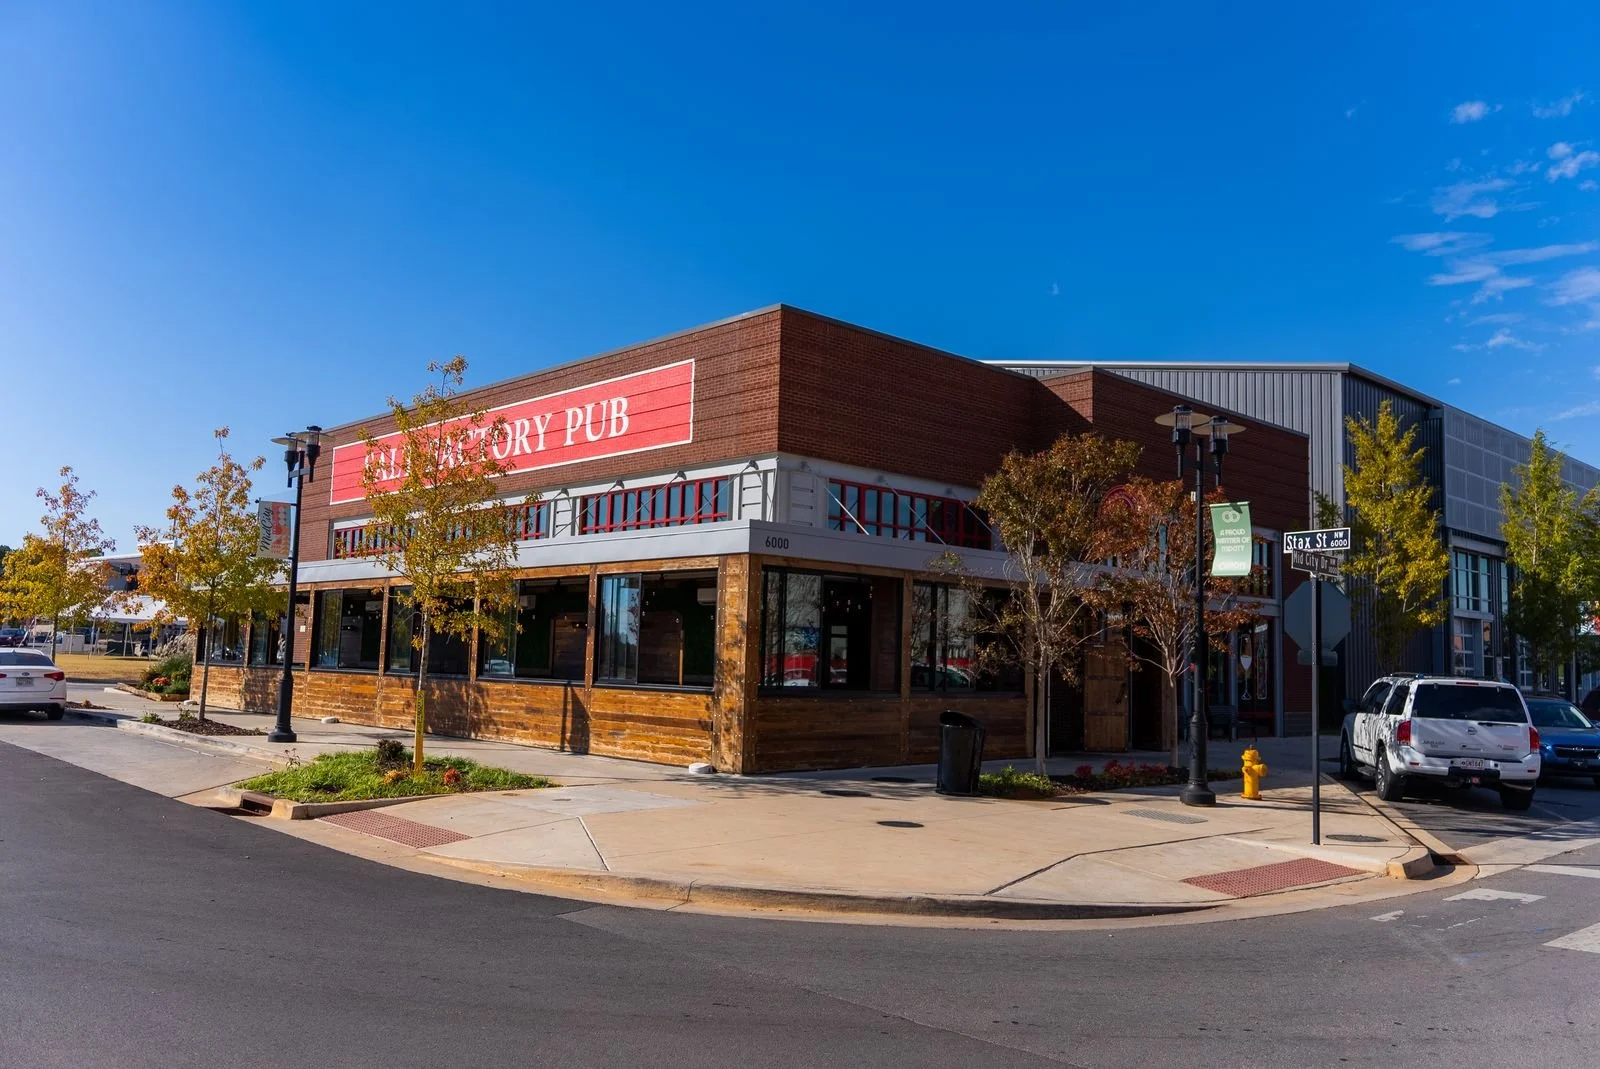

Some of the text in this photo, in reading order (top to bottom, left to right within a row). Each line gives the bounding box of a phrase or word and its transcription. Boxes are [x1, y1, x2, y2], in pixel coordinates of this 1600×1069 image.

[563, 396, 629, 446] PUB
[765, 536, 790, 550] 6000
[1286, 532, 1327, 550] Stax St
[1333, 531, 1344, 539] NW
[1330, 539, 1348, 548] 6000
[1293, 550, 1304, 565] Mid
[1305, 553, 1319, 571] City
